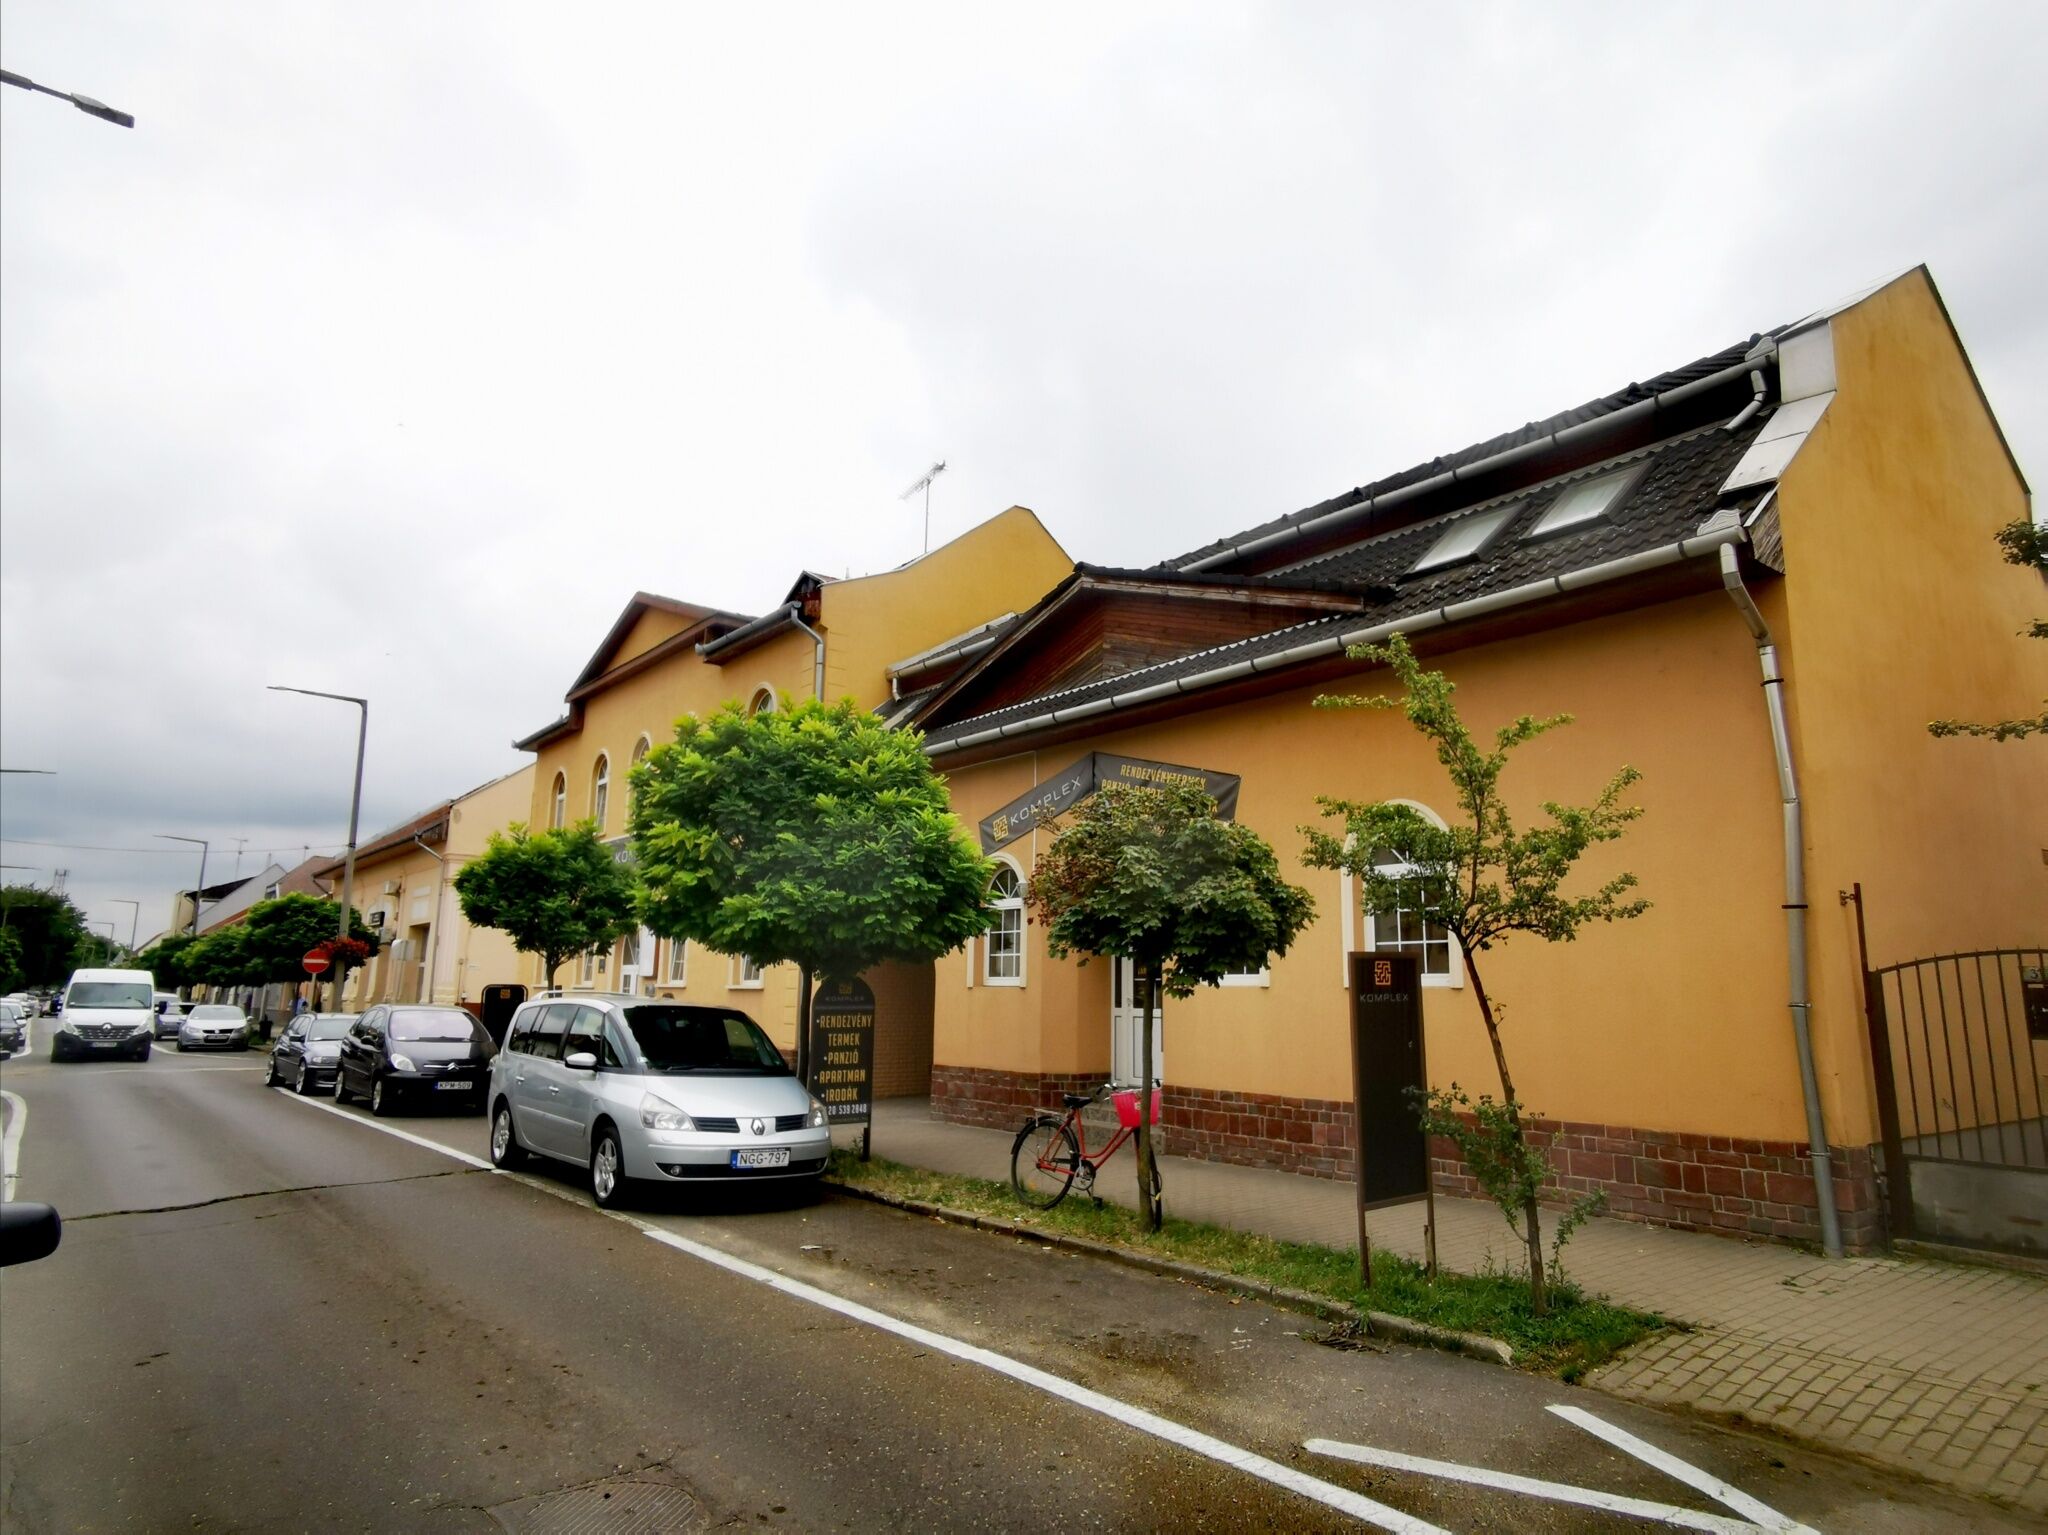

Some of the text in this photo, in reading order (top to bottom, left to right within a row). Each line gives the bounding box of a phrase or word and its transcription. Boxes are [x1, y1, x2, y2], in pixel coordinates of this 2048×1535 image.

[1010, 776, 1081, 826] KOMPLEX
[1360, 993, 1409, 1003] KOMPLEX
[820, 1013, 872, 1028] RENDEZVÉNY
[828, 1032, 860, 1047] TERMEK
[828, 1049, 859, 1064] PANZIÓ
[819, 1069, 866, 1084] APARTMAN
[826, 1086, 858, 1102] IRODÁK
[739, 1152, 787, 1165] NGG-797
